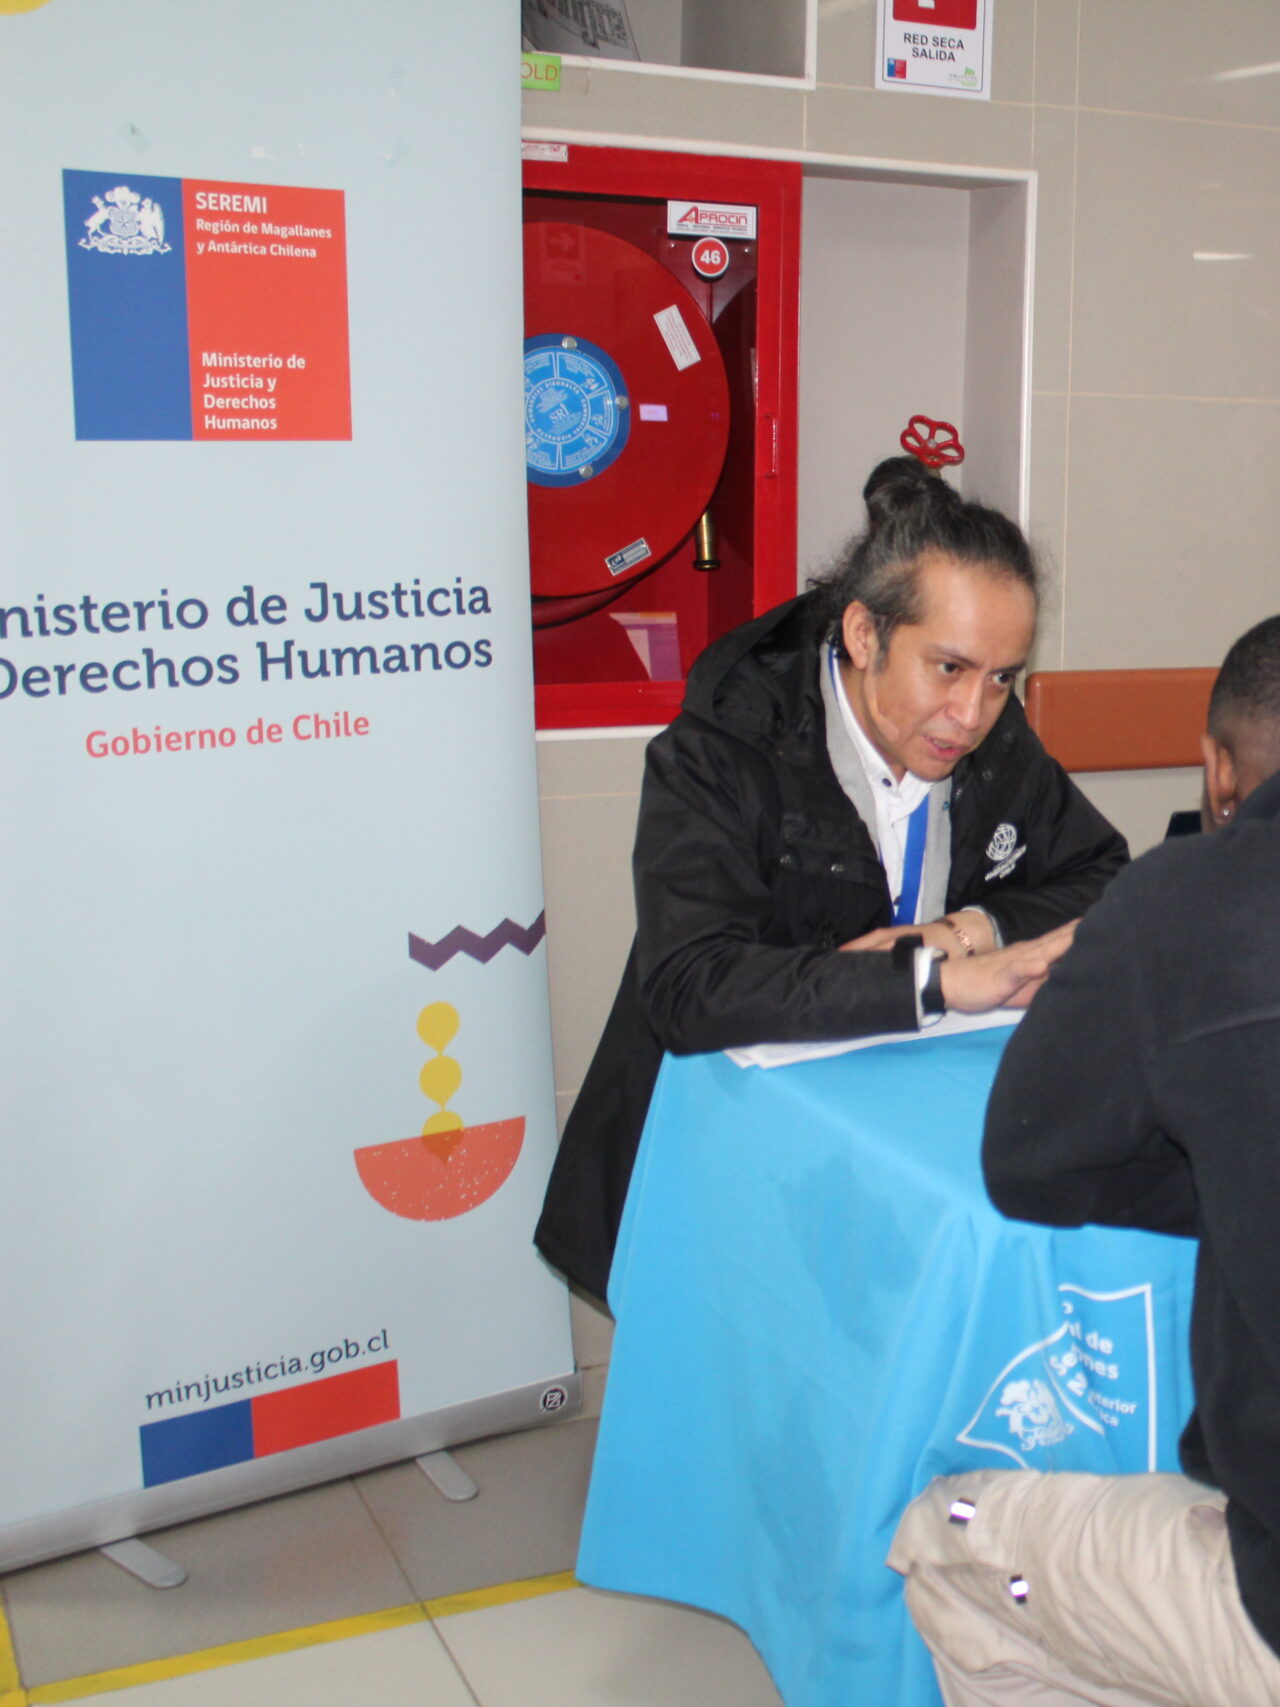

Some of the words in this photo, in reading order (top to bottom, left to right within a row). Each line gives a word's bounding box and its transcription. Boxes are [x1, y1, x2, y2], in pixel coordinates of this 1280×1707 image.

[903, 32, 929, 46] RED
[931, 35, 965, 50] SECA
[911, 46, 956, 62] SALIDA
[195, 191, 268, 214] SEREMI
[196, 218, 240, 235] Región
[242, 221, 259, 234] de
[261, 222, 333, 239] Magallanes
[196, 241, 205, 255] y
[207, 240, 267, 256] Antártica
[269, 243, 317, 259] Chilena
[700, 248, 722, 265] 46
[202, 352, 284, 369] Ministerio
[286, 354, 306, 369] de
[203, 373, 264, 389] Justicia
[267, 377, 277, 393] y
[203, 393, 277, 410] Derechos
[204, 414, 278, 431] Humanos
[0, 588, 209, 639] nisterio
[226, 585, 288, 627] de
[304, 576, 493, 623] Justicia
[256, 638, 494, 683] Humanos
[85, 724, 237, 759] Gobierno
[246, 717, 284, 746] de
[292, 710, 371, 741] Chile
[1085, 1330, 1114, 1355] de
[145, 1328, 390, 1411] minjusticia.gob.cl
